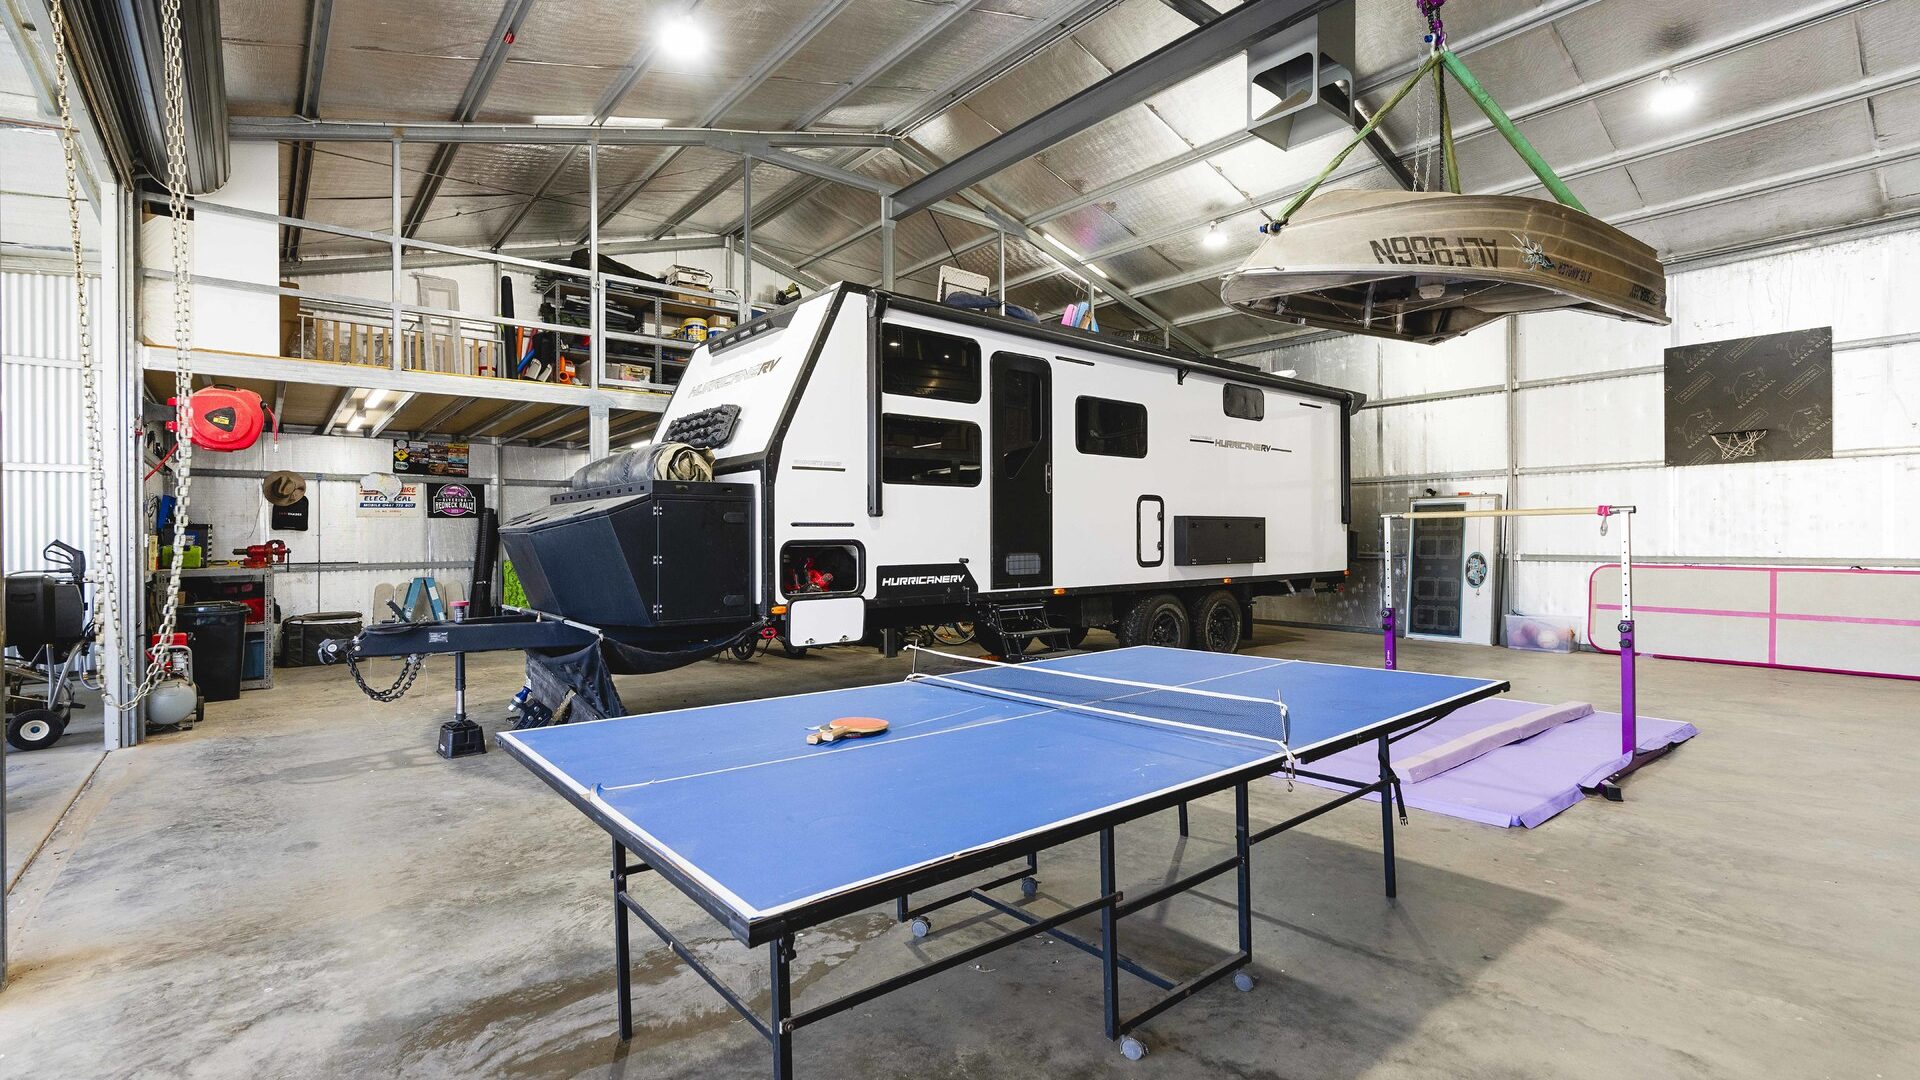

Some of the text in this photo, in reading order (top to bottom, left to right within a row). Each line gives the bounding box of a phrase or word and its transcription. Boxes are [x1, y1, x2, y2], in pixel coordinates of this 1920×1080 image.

[1369, 236, 1498, 268] ALF966N
[1687, 344, 1722, 373] BLACK BULL
[1792, 334, 1832, 367] BLACK BULL
[1737, 379, 1776, 409] BLACK BULL
[1214, 438, 1272, 452] HURRICANERV
[1687, 434, 1707, 449] BLACK
[1707, 421, 1723, 433] BULL
[1793, 417, 1832, 448] BLACK BULL
[435, 501, 474, 511] REDNECK RALLY
[881, 574, 966, 587] HURRICANERV
